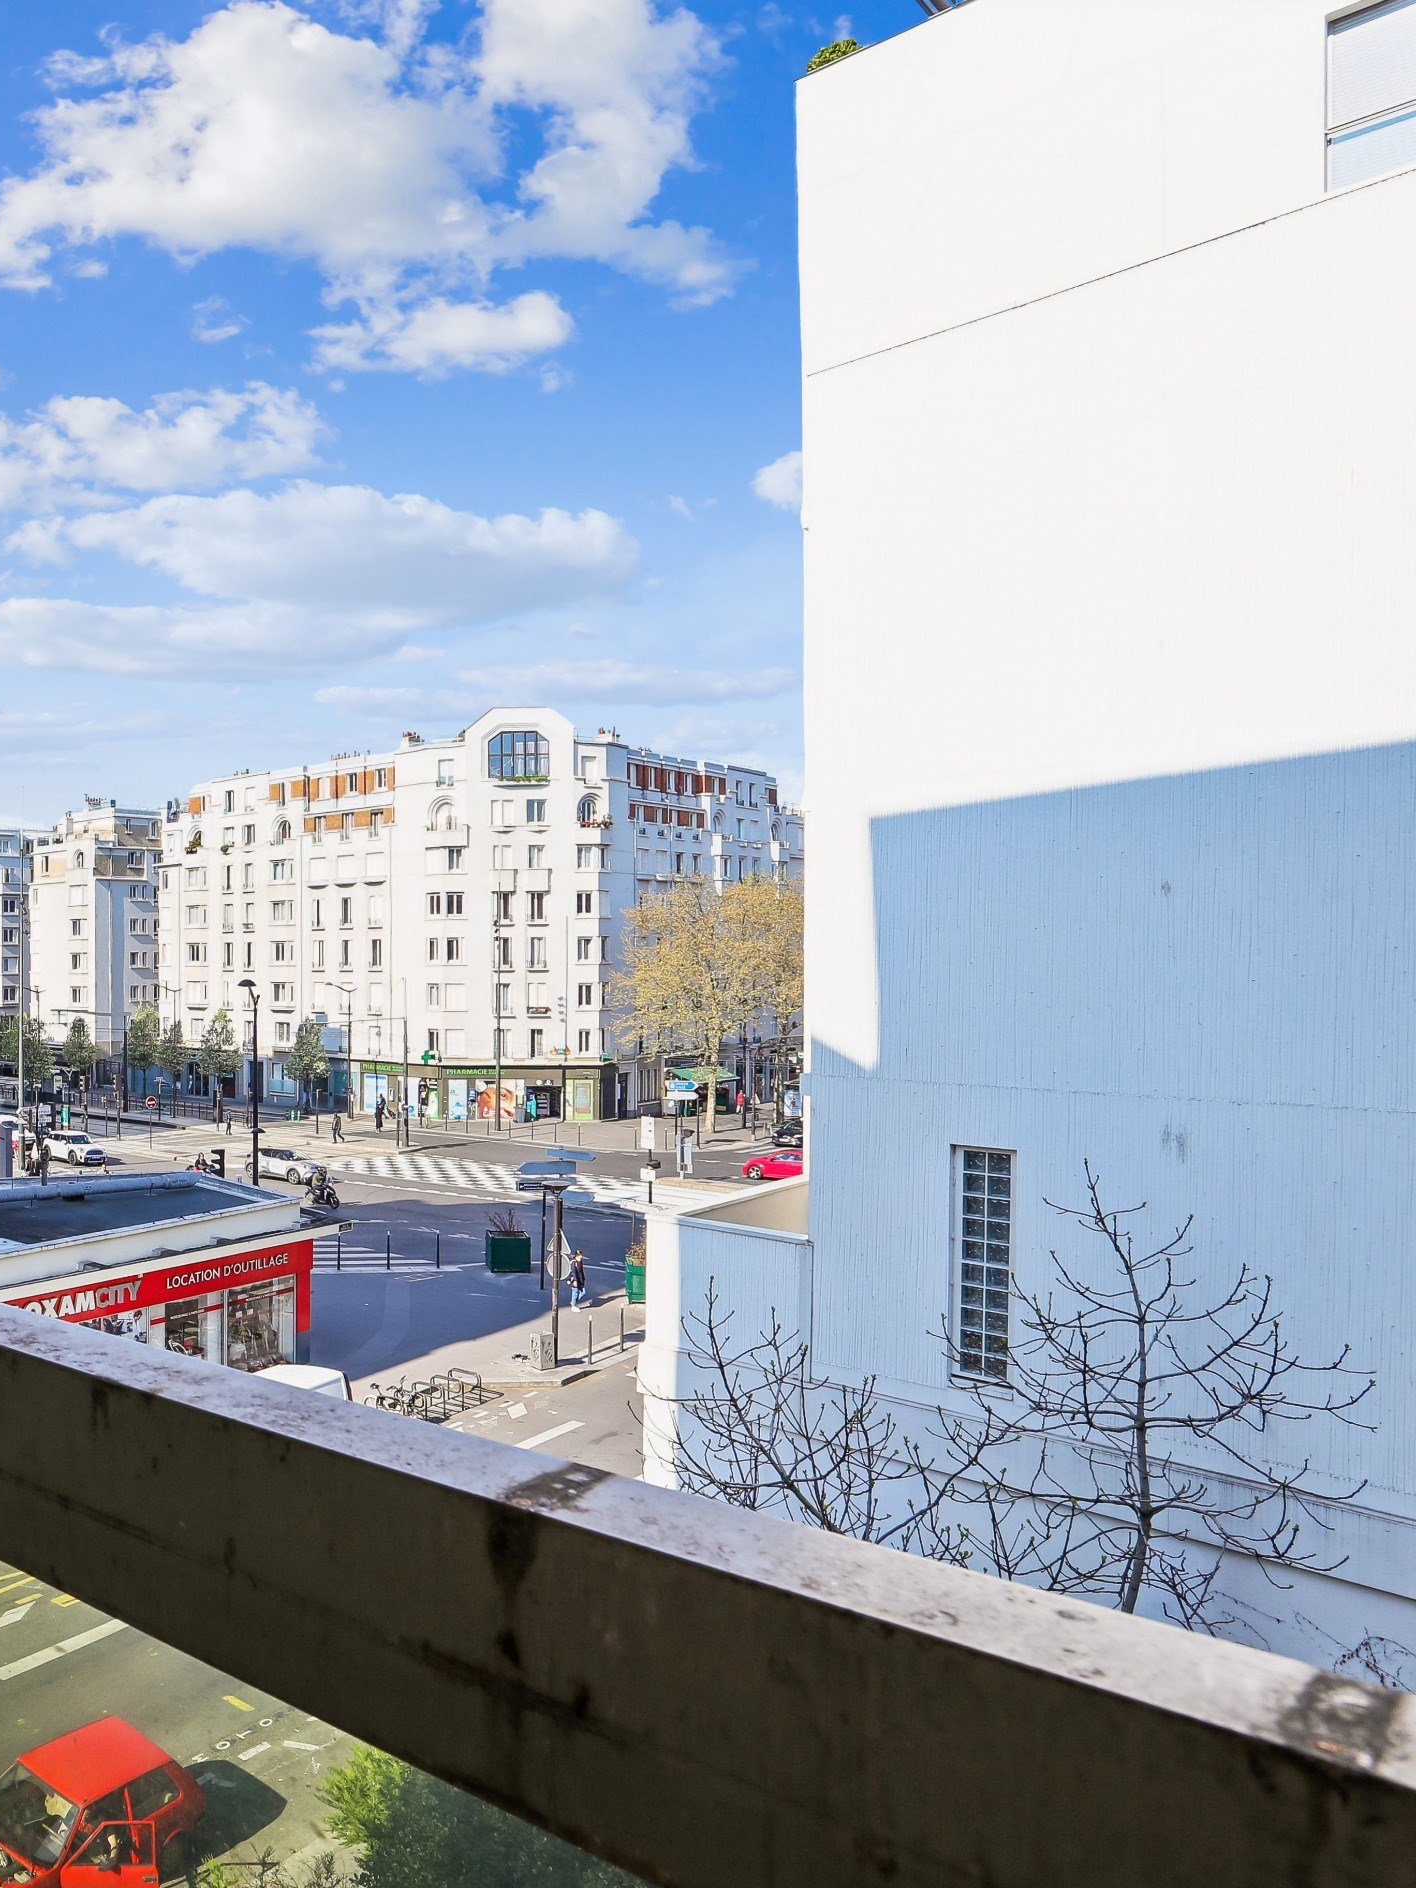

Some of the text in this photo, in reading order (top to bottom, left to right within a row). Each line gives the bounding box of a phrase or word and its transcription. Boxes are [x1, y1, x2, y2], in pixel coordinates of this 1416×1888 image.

[166, 1253, 289, 1290] LOCATION D'OUTILLAGE
[16, 1280, 142, 1319] OXAMCITY
